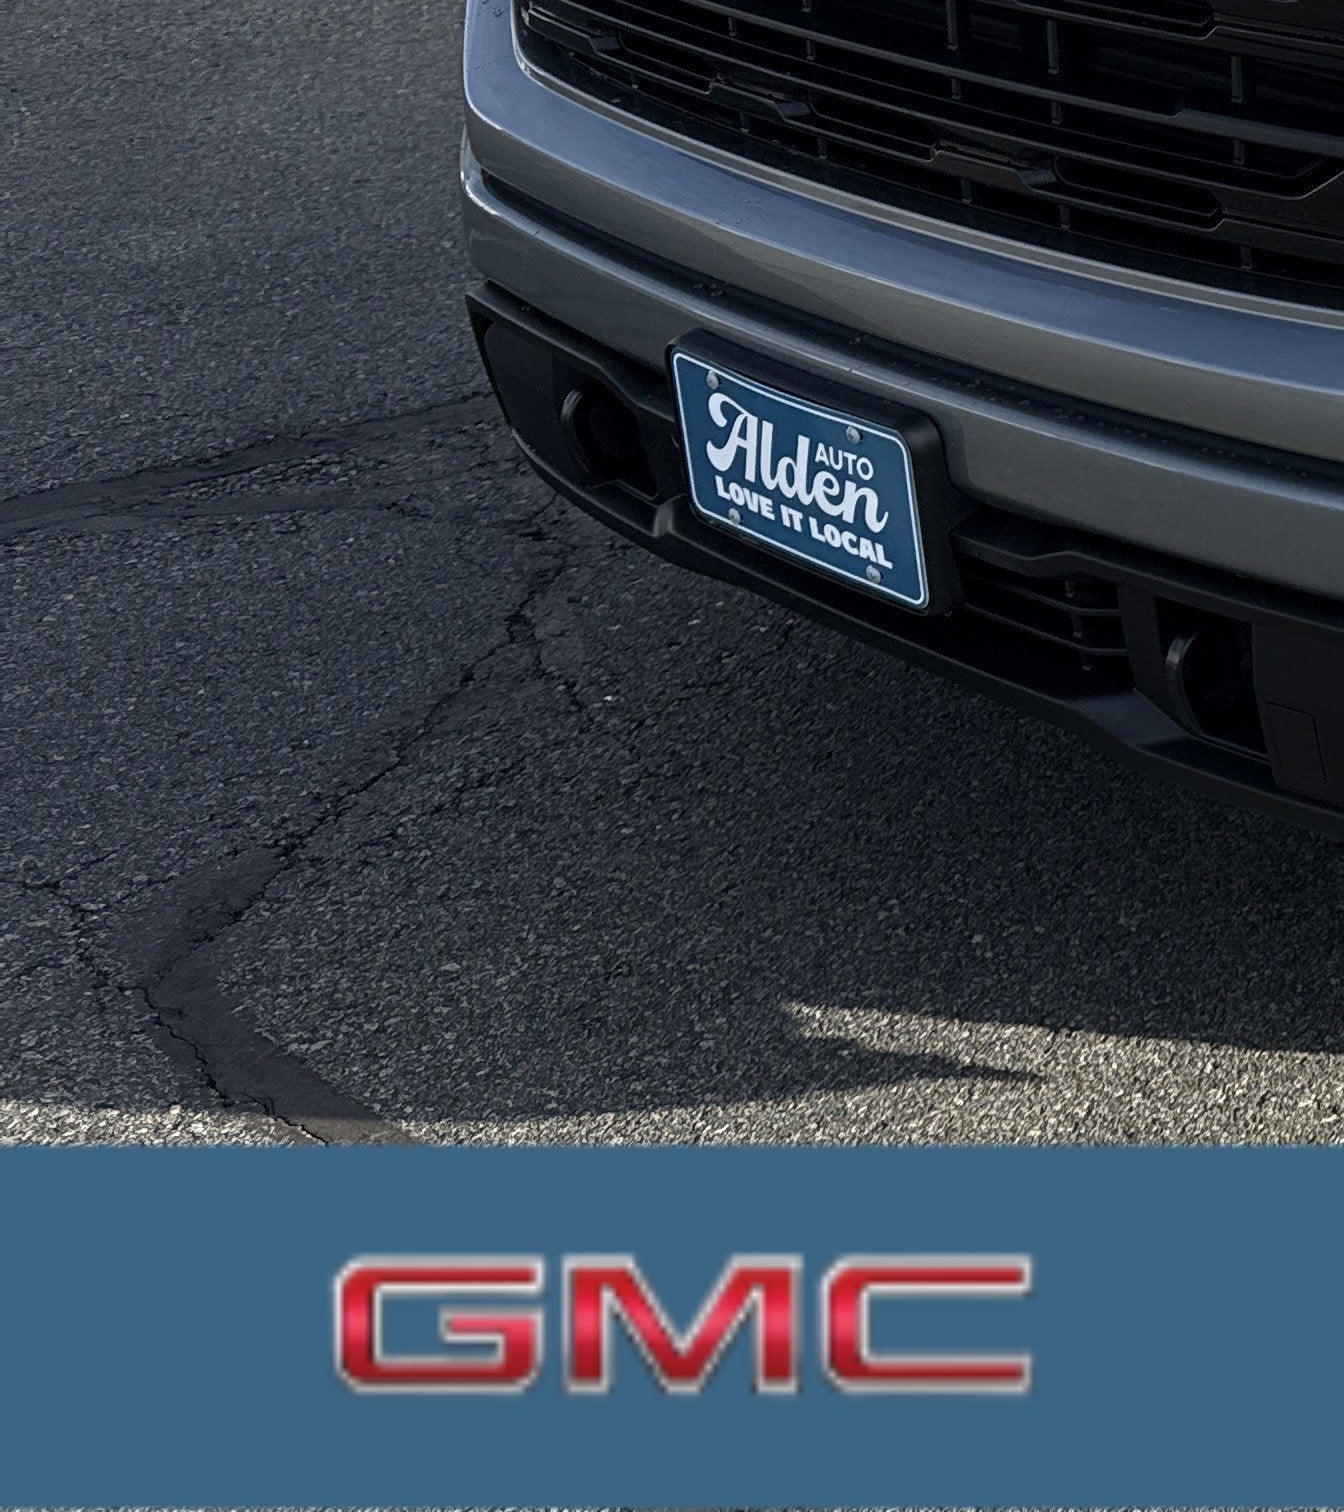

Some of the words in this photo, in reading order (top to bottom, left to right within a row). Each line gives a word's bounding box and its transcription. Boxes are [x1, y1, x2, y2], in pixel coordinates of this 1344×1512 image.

[706, 392, 889, 534] Alden
[815, 442, 874, 481] AUTO
[715, 475, 775, 521] LOVE
[780, 501, 804, 532] IT
[808, 515, 893, 570] LOCAL
